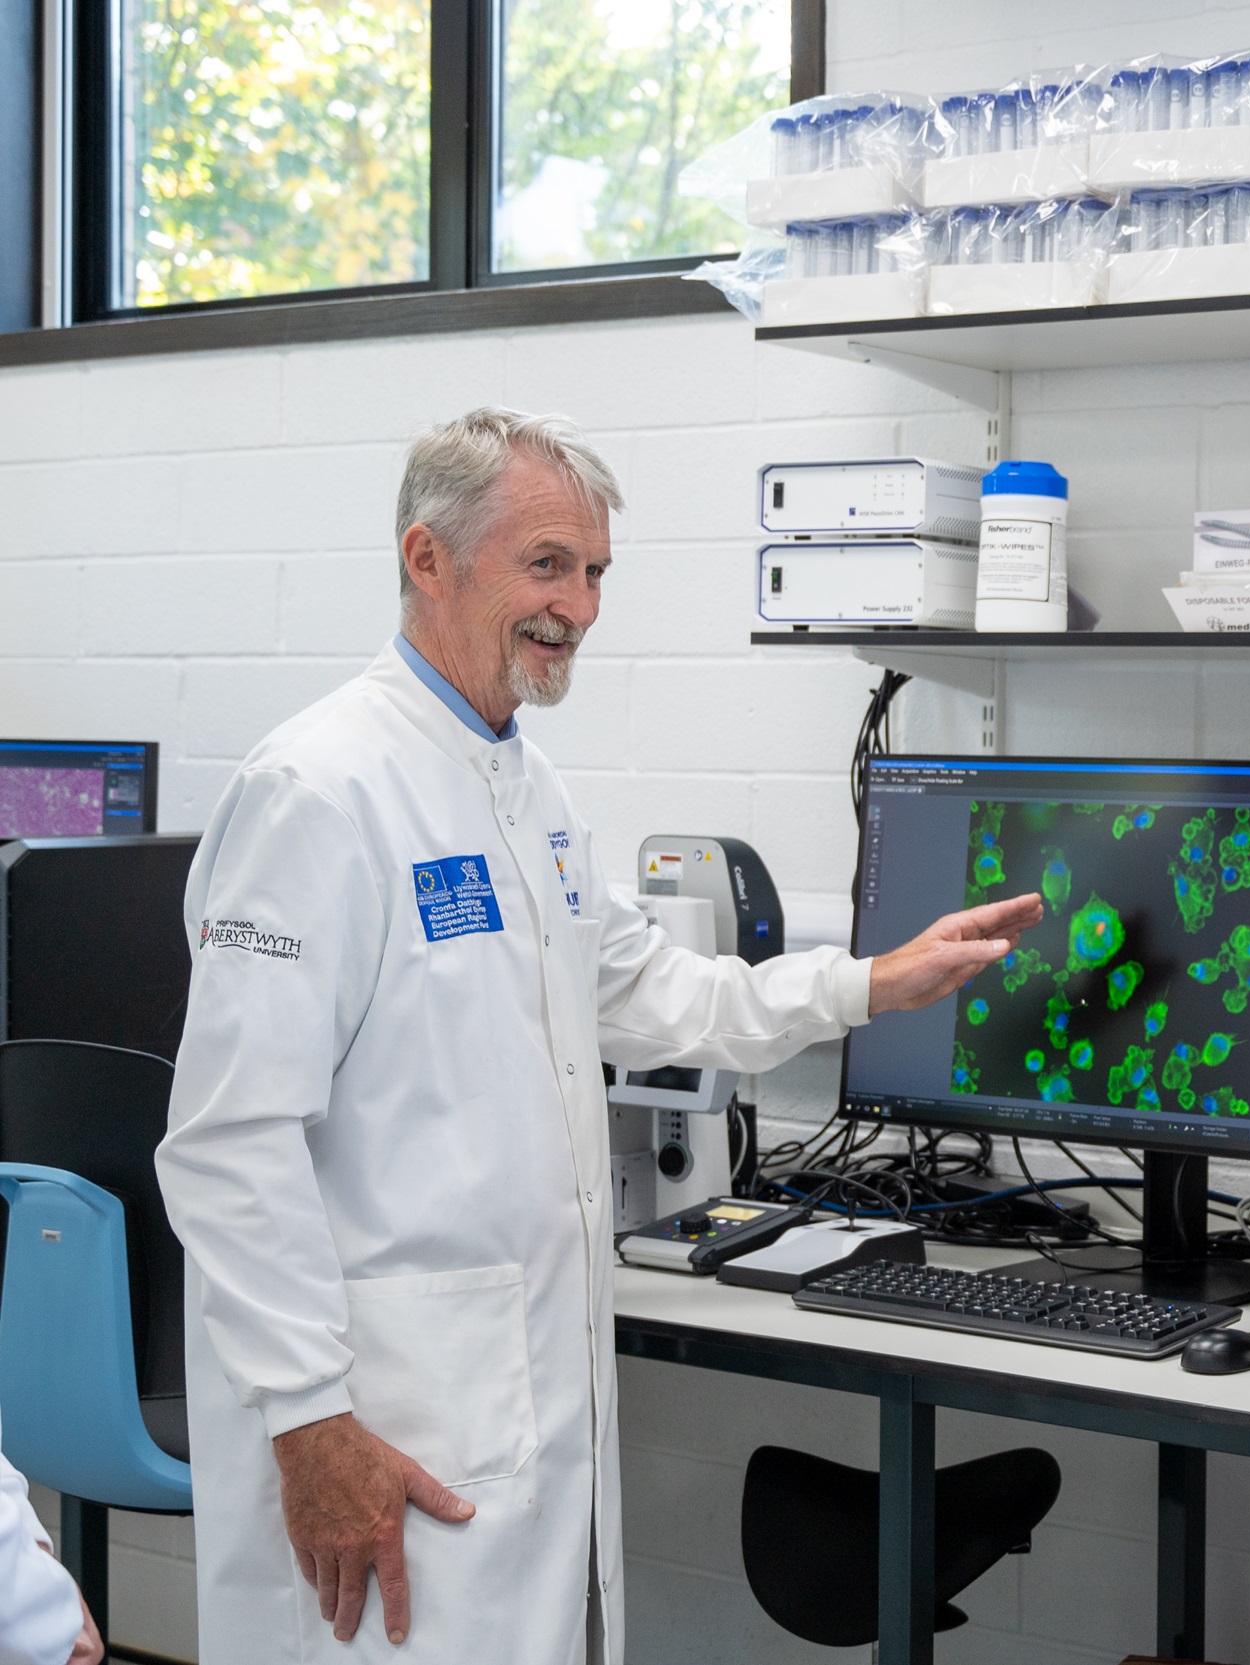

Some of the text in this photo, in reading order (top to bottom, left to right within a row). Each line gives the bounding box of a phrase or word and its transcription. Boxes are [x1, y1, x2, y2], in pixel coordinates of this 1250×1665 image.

[1185, 597, 1235, 605] DISPOSABLE
[882, 605, 902, 614] Supply
[734, 866, 750, 911] Colibri 7
[431, 903, 456, 914] Cronfa
[216, 920, 256, 930] PRIFYSGOL
[431, 915, 466, 929] European
[433, 923, 480, 938] Development
[207, 926, 302, 953] ABERYSTWYTH
[253, 946, 300, 961] UNIVERSITY
